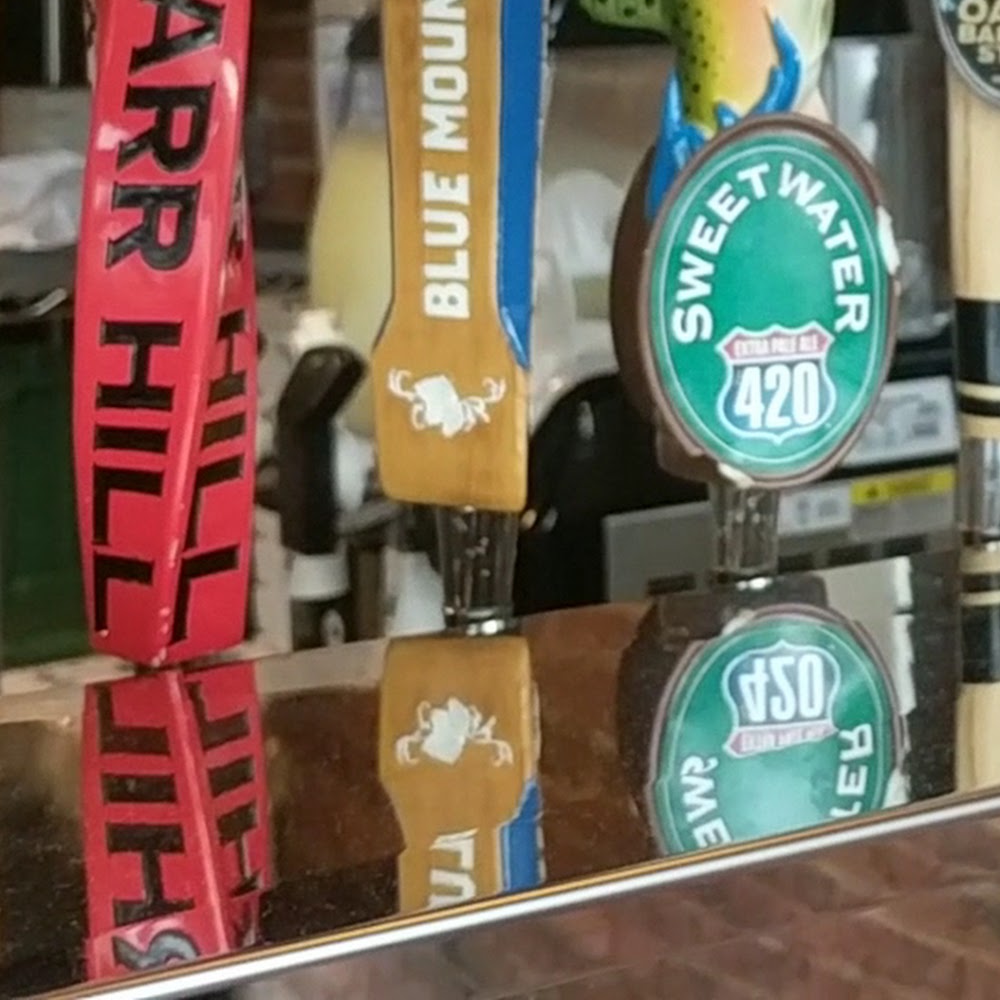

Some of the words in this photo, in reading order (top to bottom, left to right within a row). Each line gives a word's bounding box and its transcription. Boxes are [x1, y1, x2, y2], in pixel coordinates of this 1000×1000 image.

[421, 169, 471, 320] BLUE
[93, 318, 184, 634] HILL
[169, 308, 247, 646] HILL
[733, 361, 821, 430] 420
